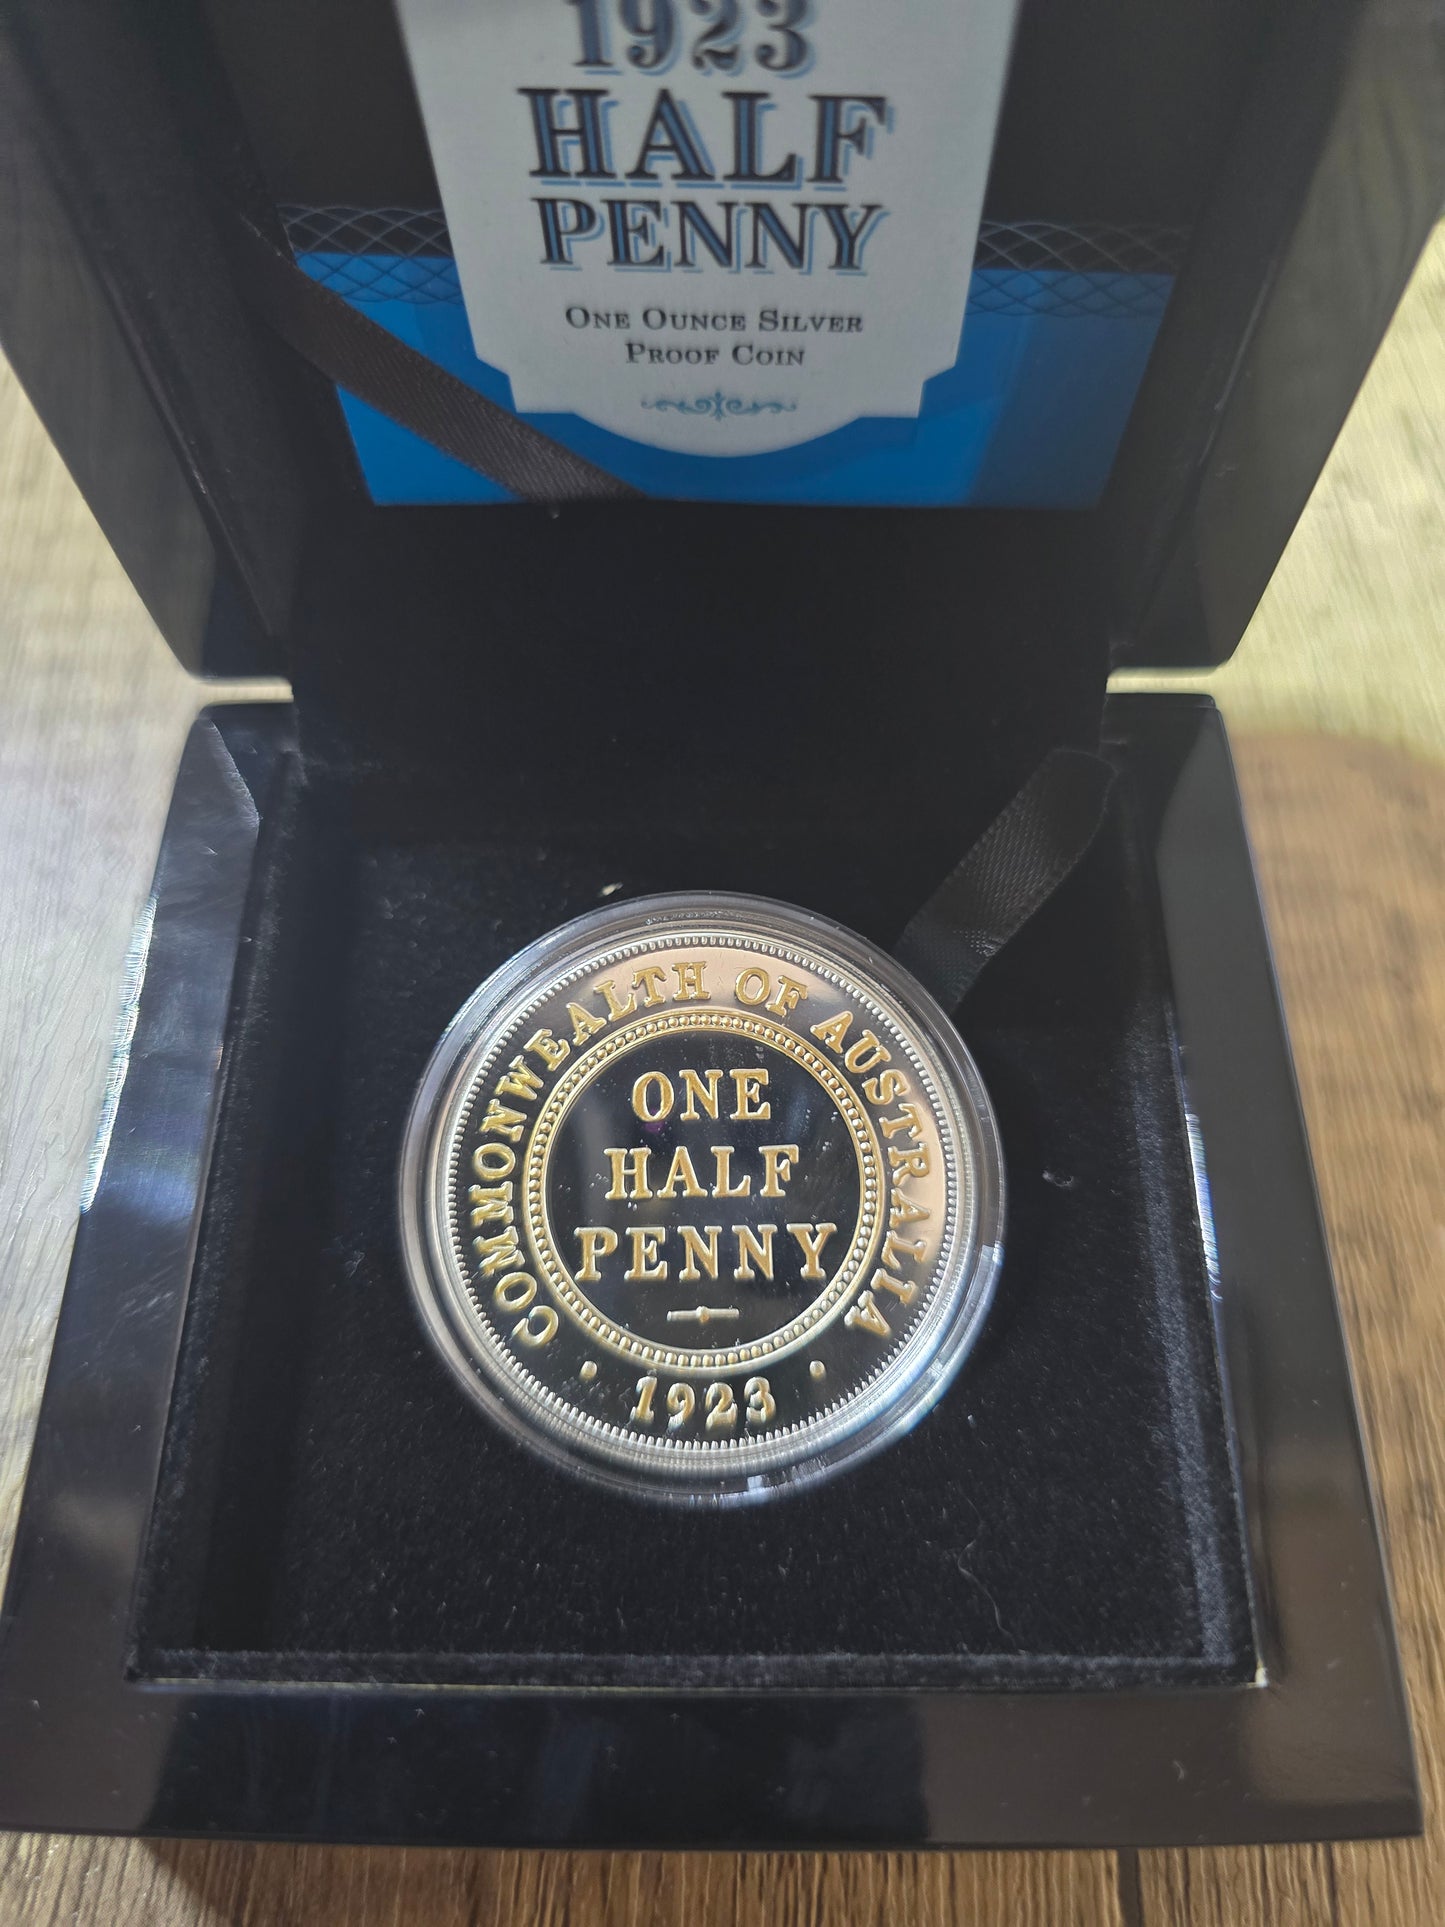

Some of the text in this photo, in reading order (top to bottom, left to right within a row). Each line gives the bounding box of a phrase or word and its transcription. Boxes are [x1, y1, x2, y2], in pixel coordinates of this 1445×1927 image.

[565, 0, 817, 79] 1923
[517, 86, 894, 192] HALF
[530, 197, 890, 276] PENNY
[565, 305, 864, 333] ONE OUNCE SILVER
[625, 342, 805, 366] PROOF COIN
[631, 1067, 772, 1123] ONE
[471, 960, 931, 1347] COMMONWEALTH OF AUSTRALIA
[603, 1143, 800, 1201] HALF
[573, 1221, 838, 1282] PENNY
[634, 1375, 777, 1429] 1923
